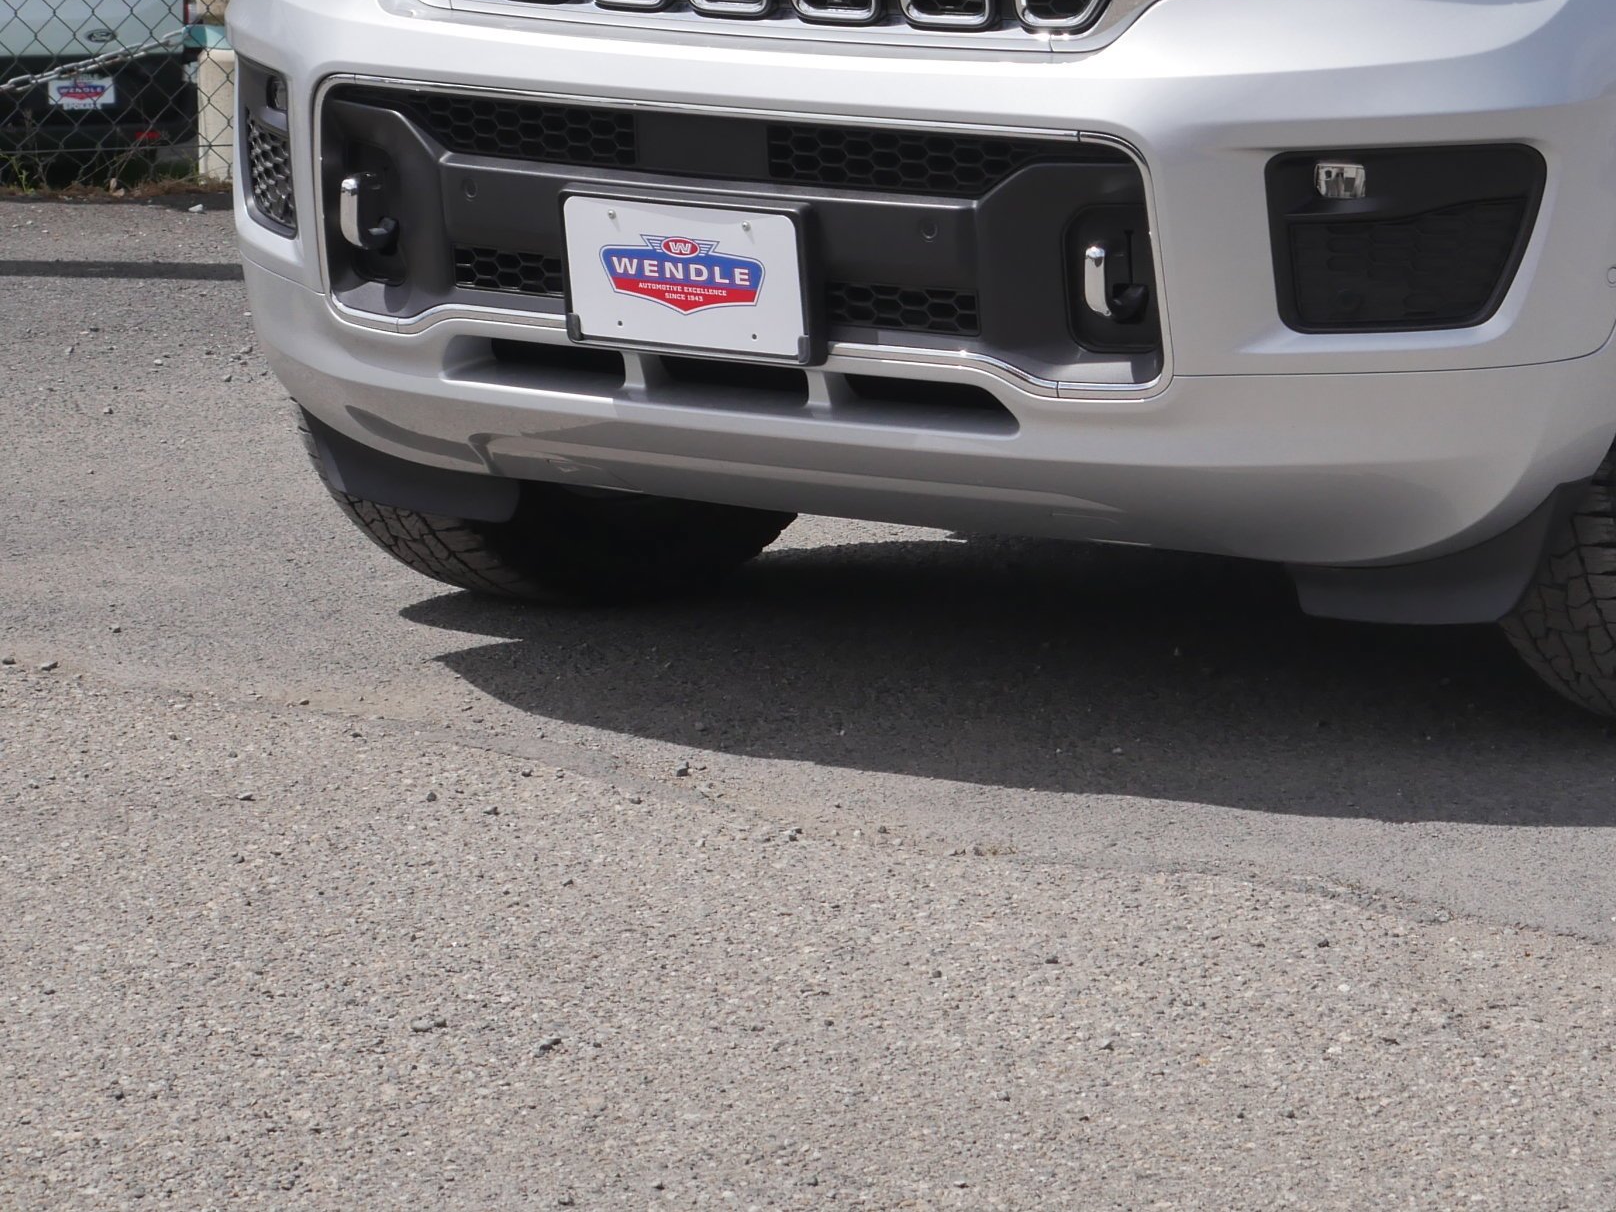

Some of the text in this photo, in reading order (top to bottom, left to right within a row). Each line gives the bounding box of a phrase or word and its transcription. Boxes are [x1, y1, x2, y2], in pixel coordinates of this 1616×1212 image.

[612, 256, 750, 286] WENDLE
[638, 282, 727, 296] AUTOMOTIVE EXCELLENCE
[665, 293, 704, 302] SINCE 1943
